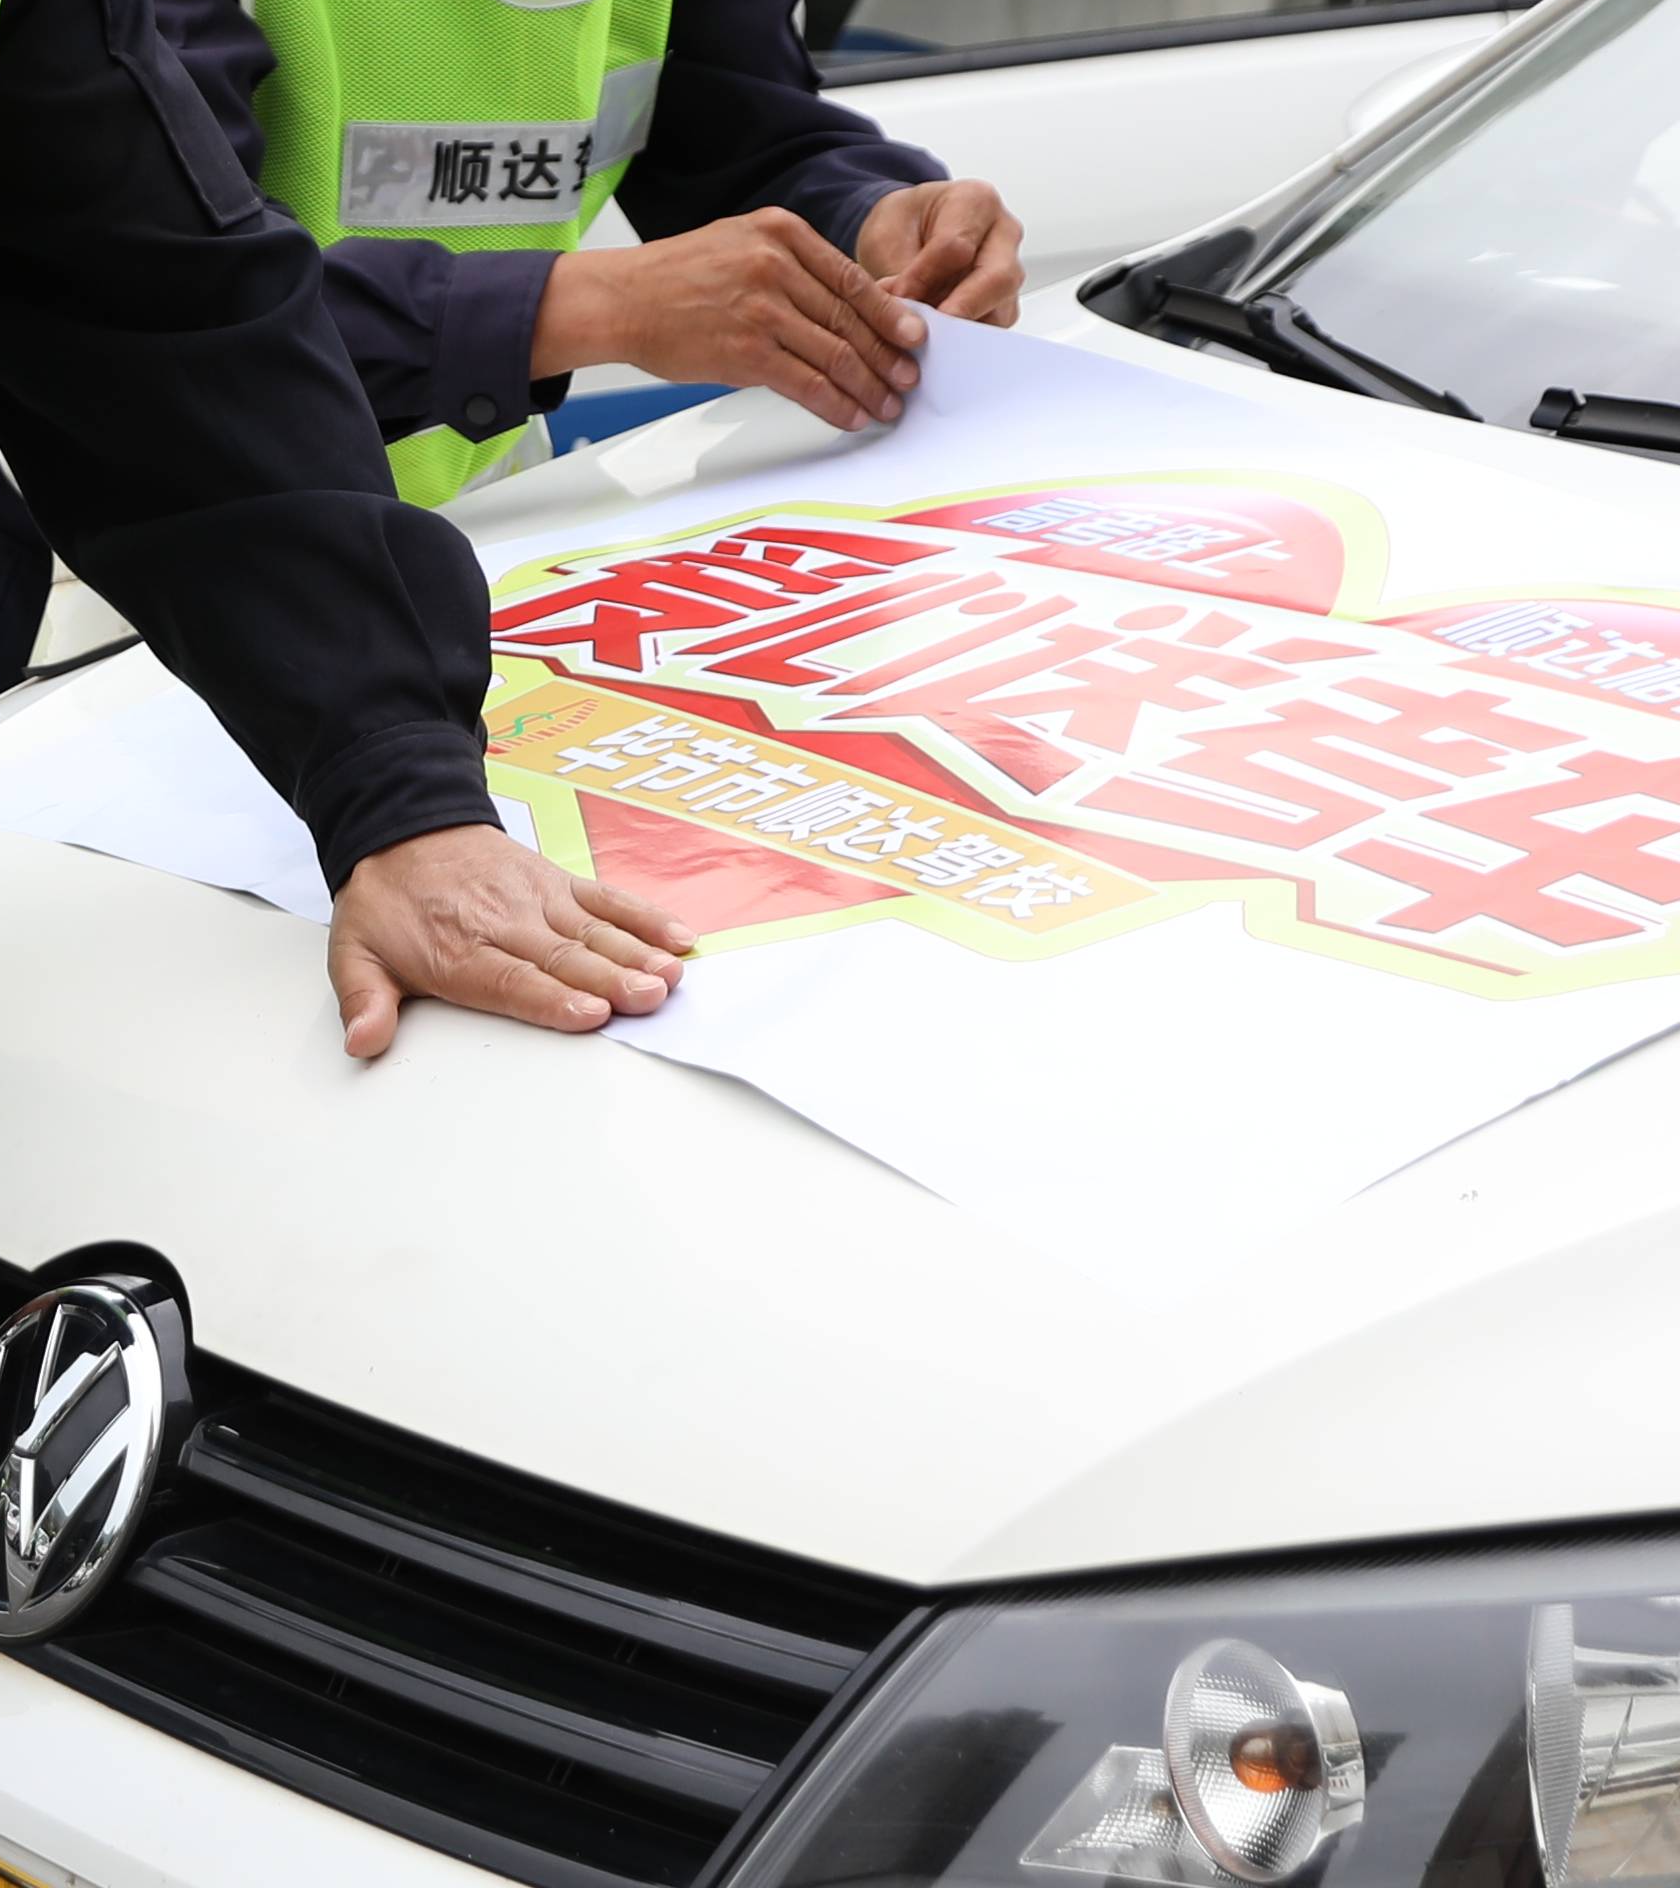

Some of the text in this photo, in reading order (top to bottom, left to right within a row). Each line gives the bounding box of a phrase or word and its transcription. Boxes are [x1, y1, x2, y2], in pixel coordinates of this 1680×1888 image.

[971, 496, 1294, 580] 高考路上
[553, 714, 1095, 920] 毕节市顺达驾校
